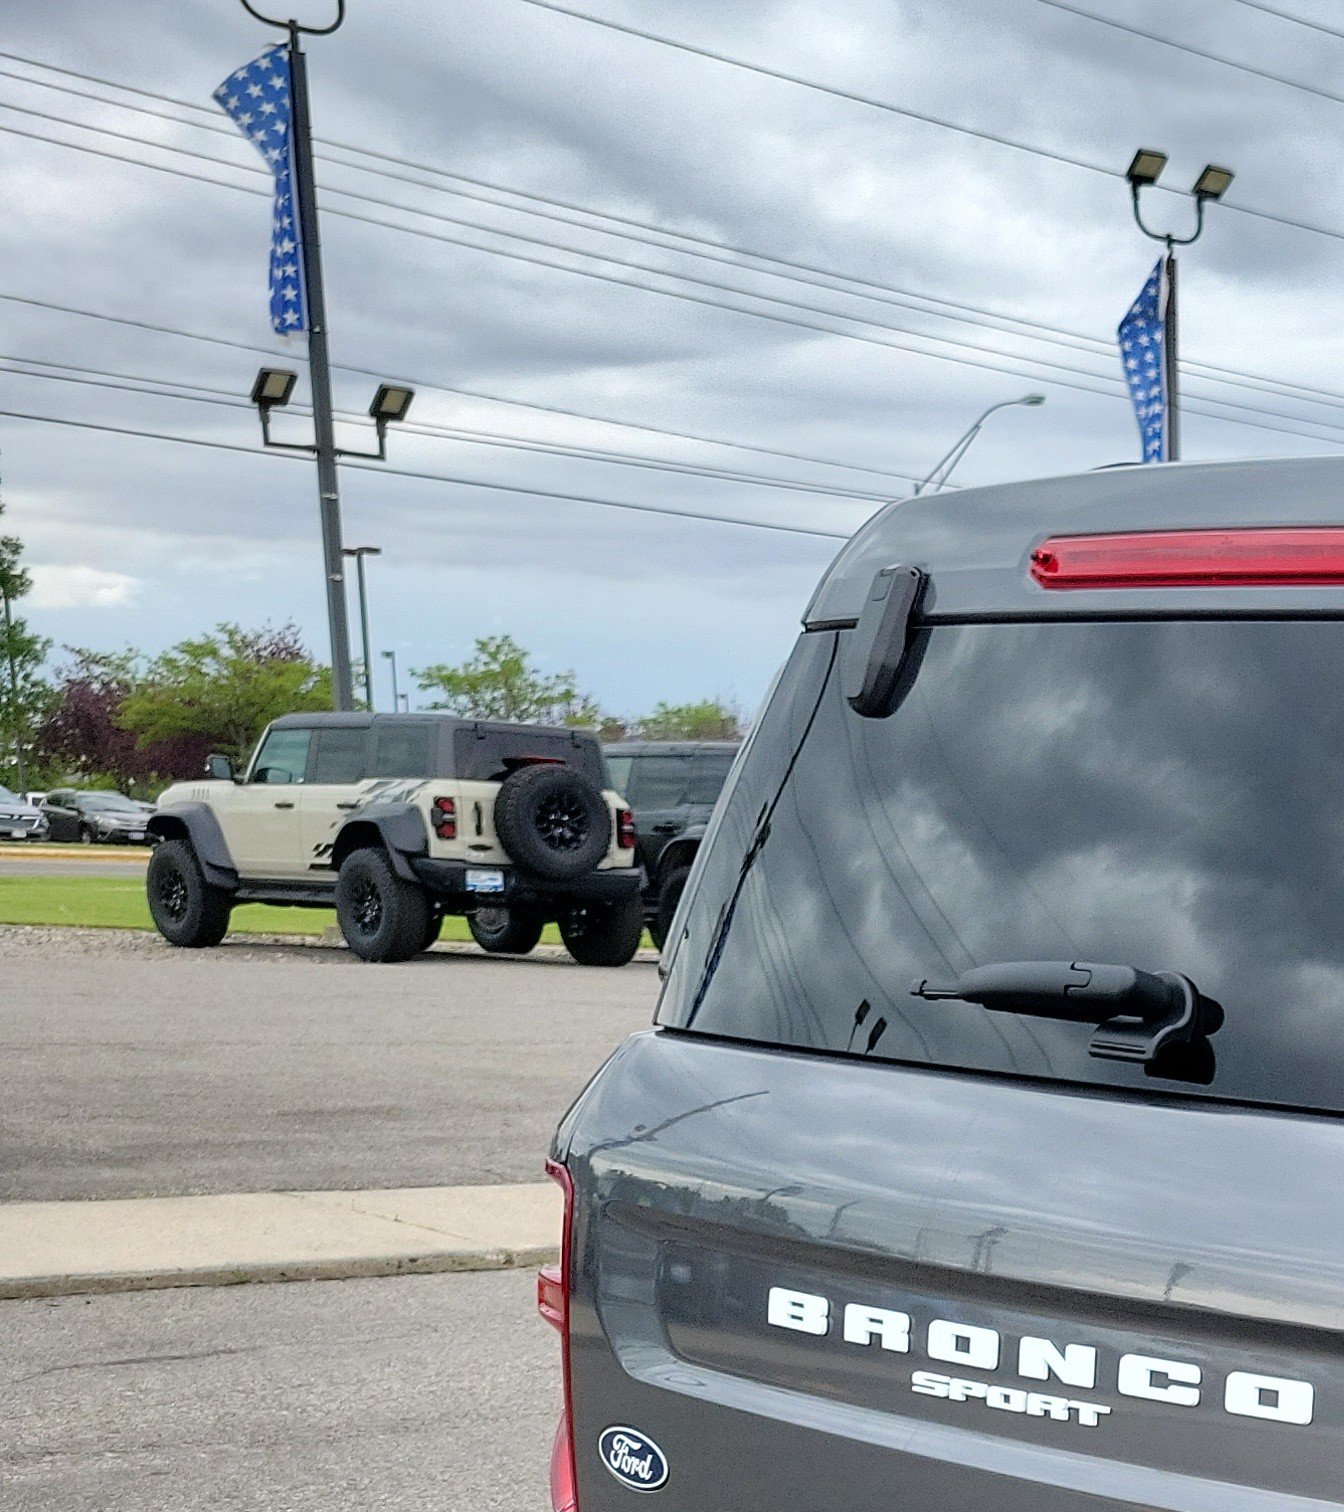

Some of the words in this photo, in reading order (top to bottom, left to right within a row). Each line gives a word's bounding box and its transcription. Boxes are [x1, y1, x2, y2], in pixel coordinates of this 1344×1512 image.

[768, 1286, 1315, 1427] BRONCO
[911, 1370, 1112, 1427] SPORT
[609, 1433, 653, 1481] Ford
